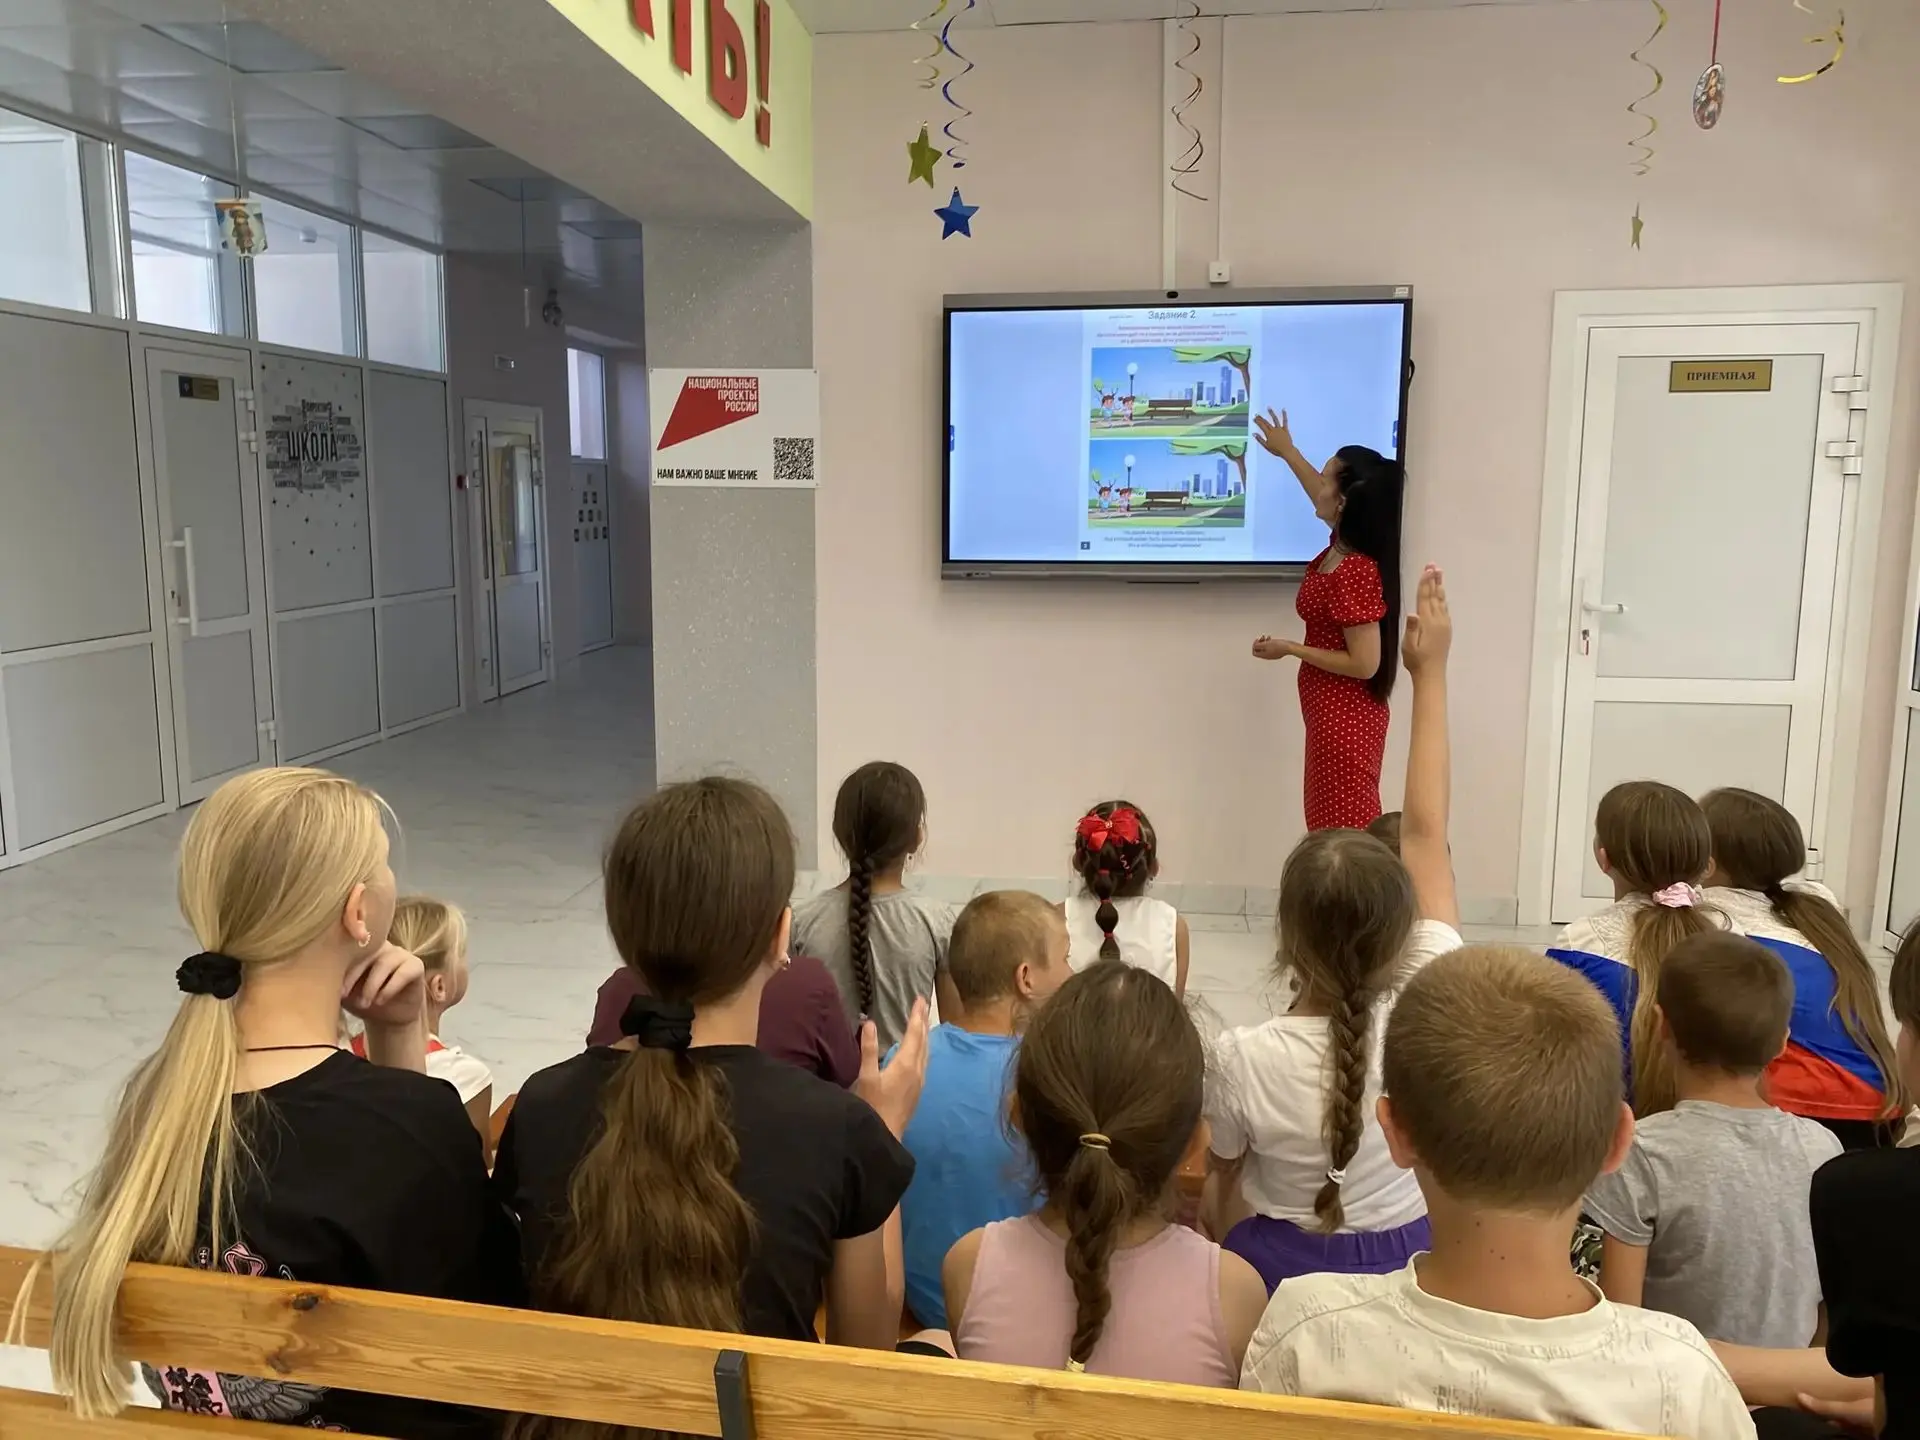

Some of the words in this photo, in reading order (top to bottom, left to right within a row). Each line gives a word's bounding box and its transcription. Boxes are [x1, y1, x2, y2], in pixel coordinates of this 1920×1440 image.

[1148, 310, 1188, 321] Задание
[1190, 310, 1197, 319] 2
[1687, 372, 1755, 381] ПРИЕМНАЯ
[688, 378, 757, 389] НАЦИОНАЛЬНЫЕ
[718, 390, 757, 400] ПРОЕКТЫ
[725, 401, 757, 412] РОССИИ
[287, 431, 338, 461] ШКОЛА
[657, 469, 674, 479] НАМ
[676, 469, 703, 480] ВАЖНО
[705, 470, 726, 480] ВАШЕ
[728, 470, 758, 480] МНЕНИЕ
